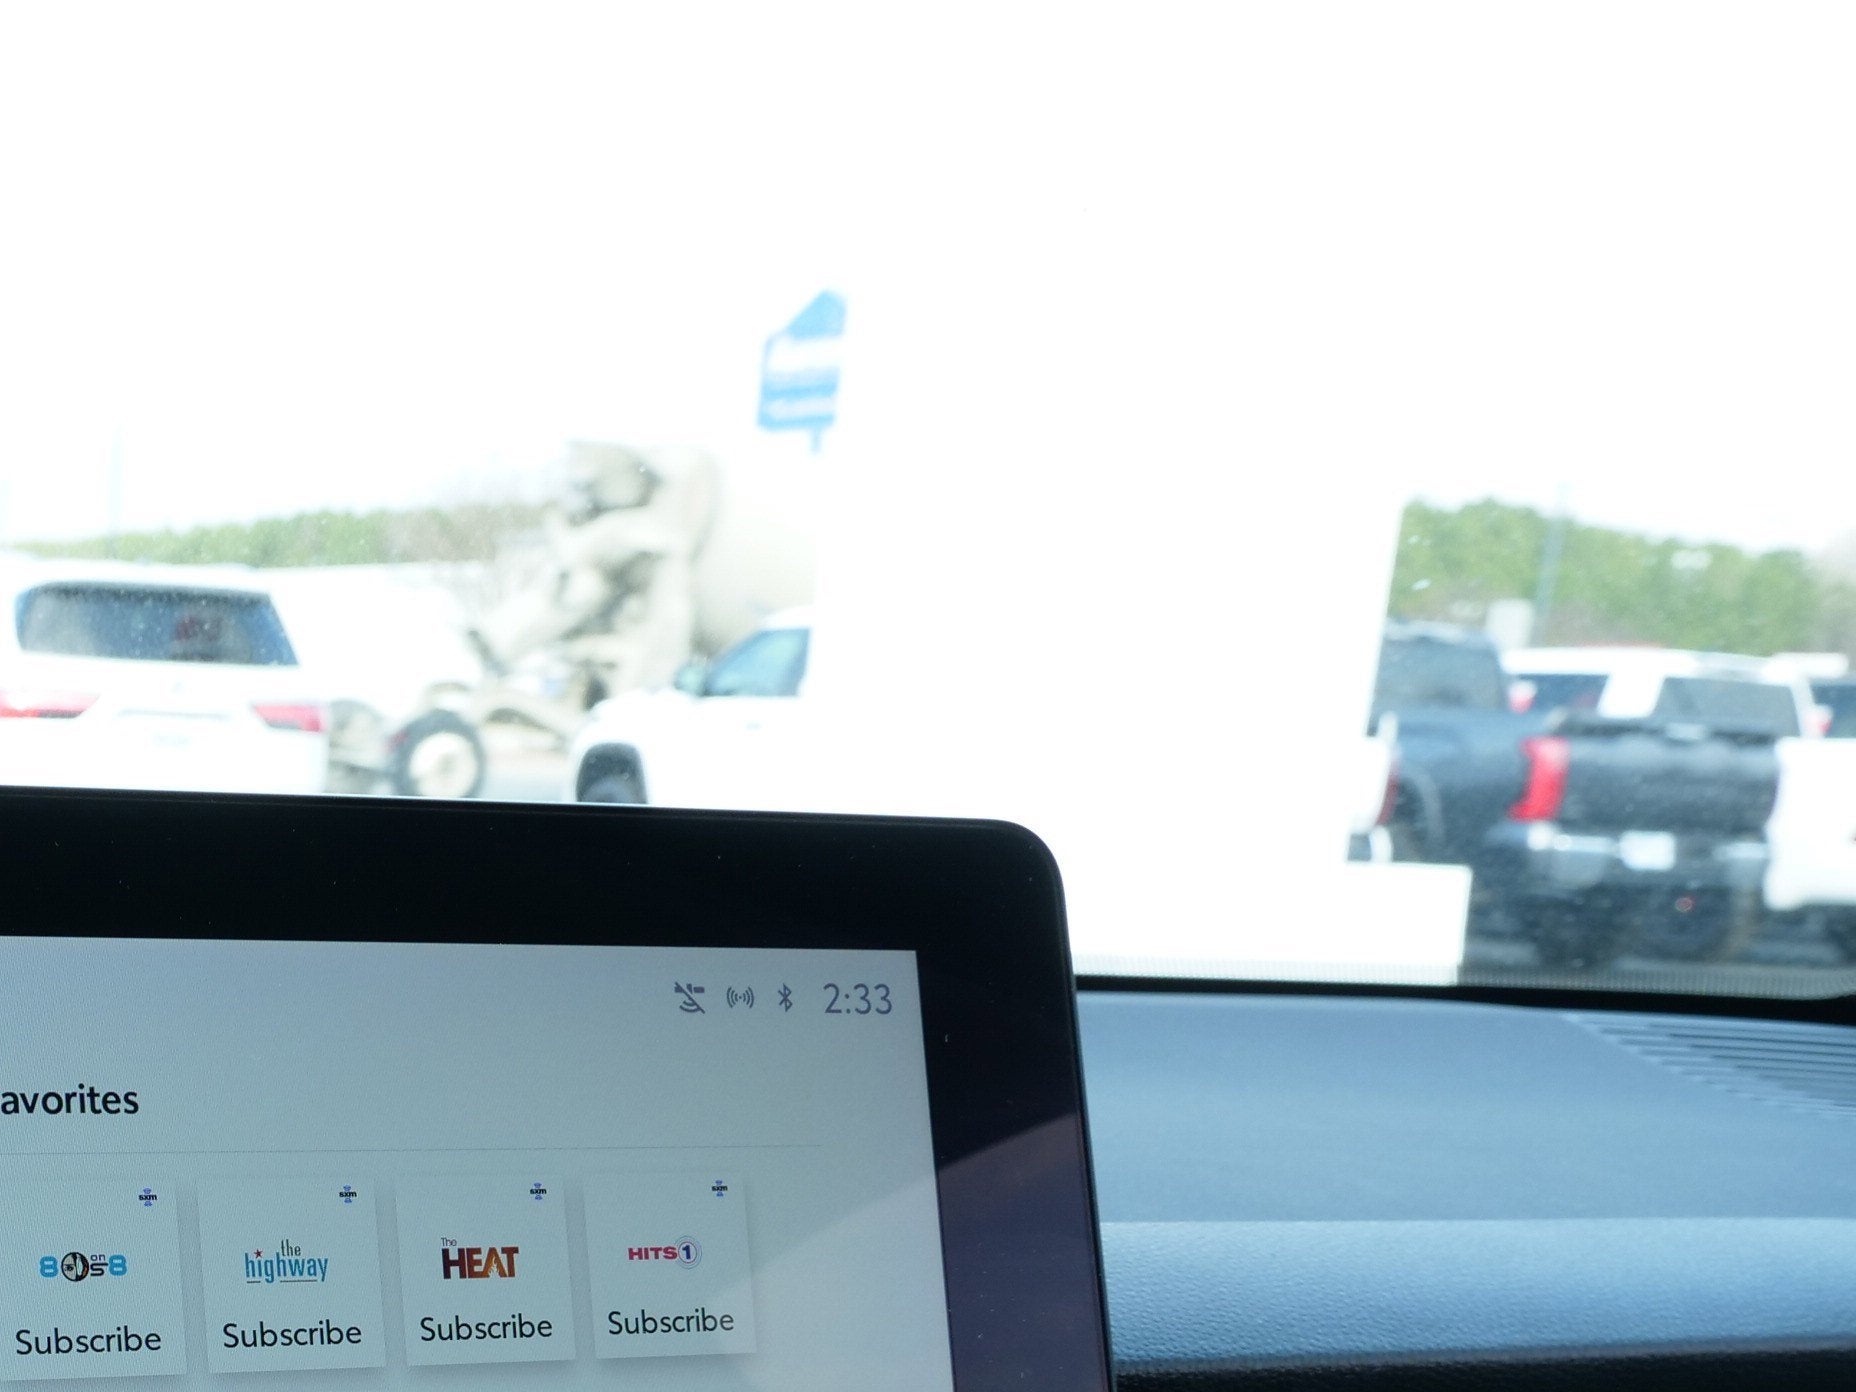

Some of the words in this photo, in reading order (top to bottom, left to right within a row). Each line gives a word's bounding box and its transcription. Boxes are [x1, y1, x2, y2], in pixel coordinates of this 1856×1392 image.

[822, 982, 894, 1015] 2:33
[338, 1190, 358, 1199] sxm
[280, 1238, 302, 1257] the
[440, 1237, 458, 1247] The
[244, 1251, 329, 1284] highway
[441, 1246, 520, 1280] HEAT
[222, 1318, 362, 1349] Subscribe
[419, 1312, 553, 1342] Subscribe
[607, 1306, 735, 1336] Subscribe
[15, 1325, 162, 1356] Subscribe
